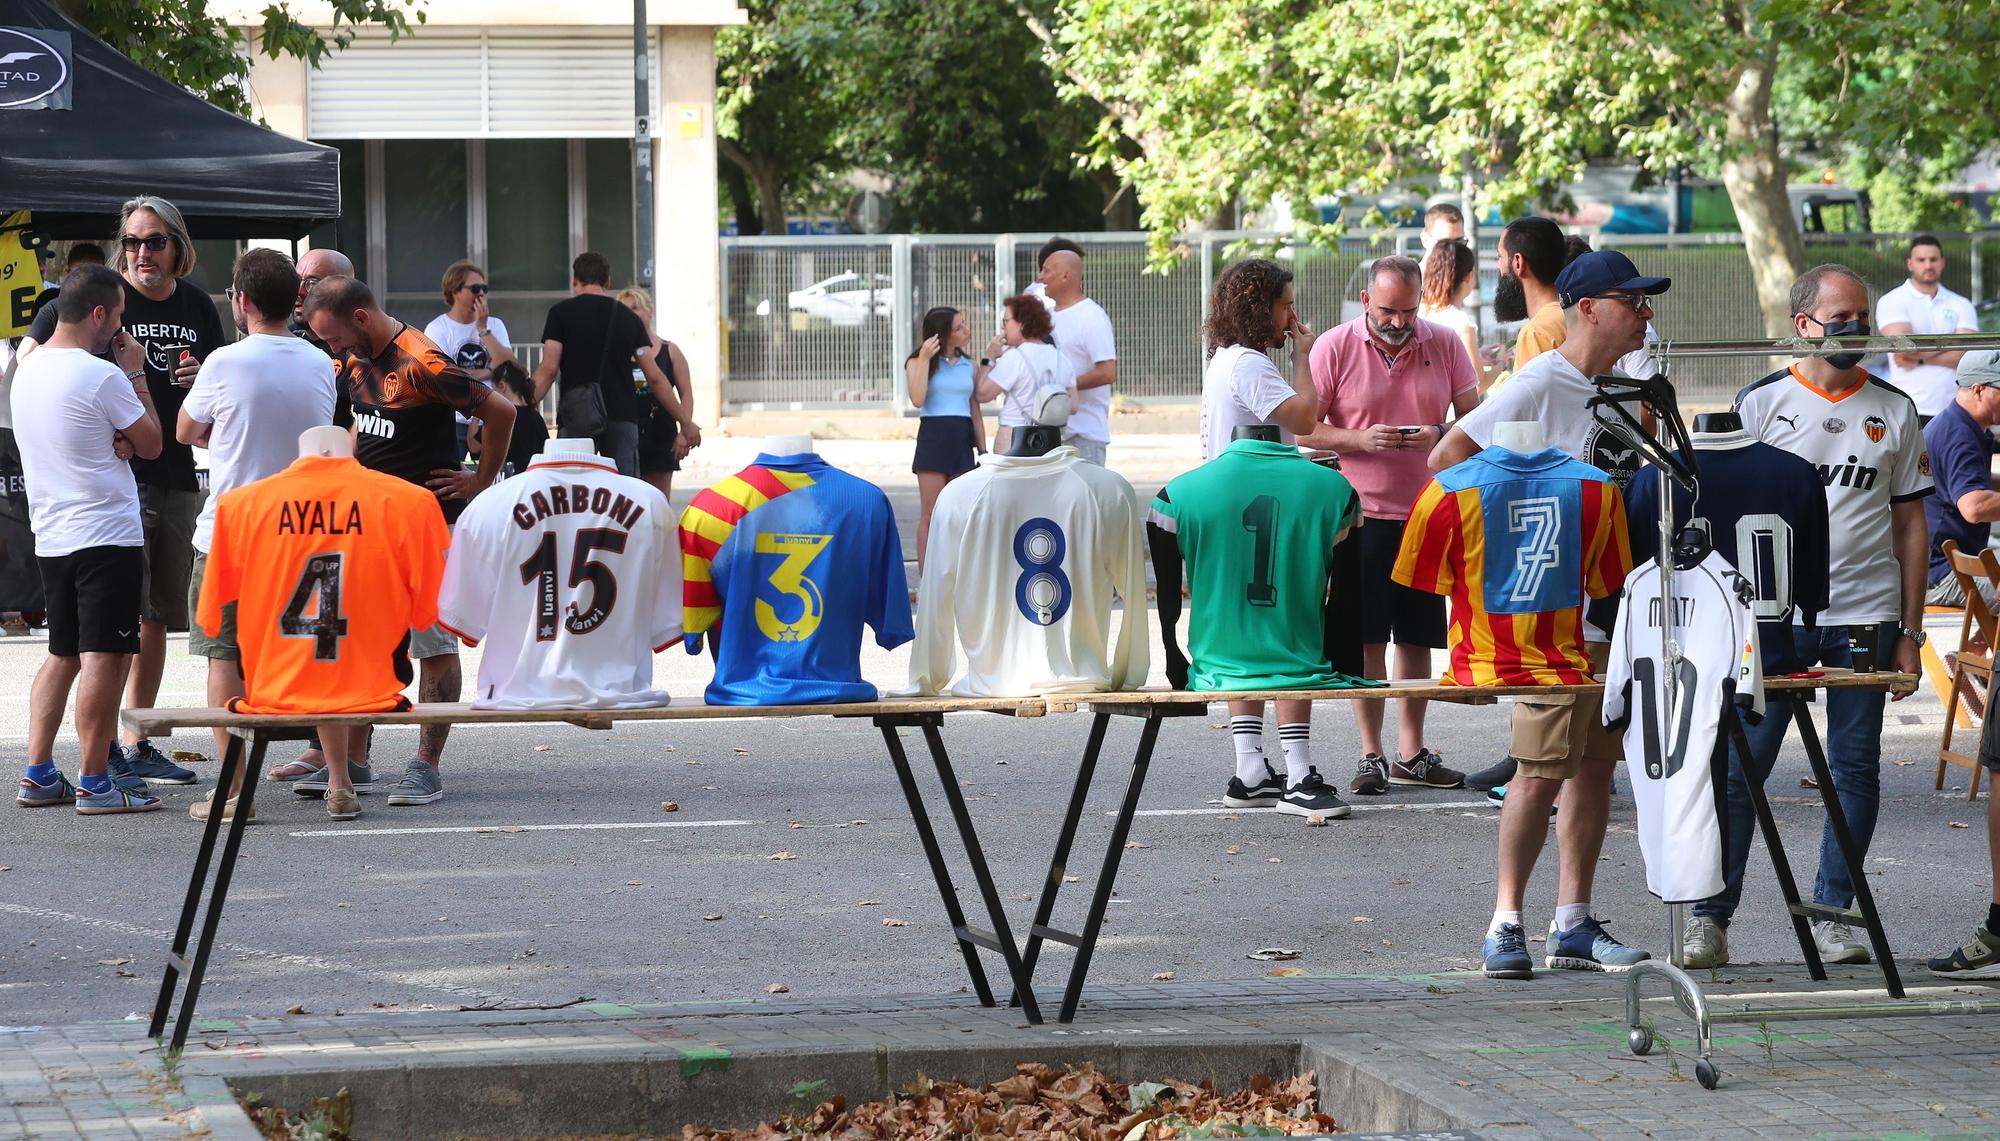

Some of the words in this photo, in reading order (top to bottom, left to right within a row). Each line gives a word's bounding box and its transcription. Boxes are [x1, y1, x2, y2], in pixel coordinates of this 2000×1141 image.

[0, 71, 40, 81] TAD
[153, 352, 167, 362] VC
[10, 475, 26, 492] ES
[1812, 455, 1878, 490] win
[278, 500, 363, 535] AYALA
[513, 484, 645, 531] CARBONI
[1013, 517, 1072, 626] 8
[1242, 494, 1281, 608] 1
[1507, 496, 1561, 602] 7
[279, 552, 348, 663] 4
[519, 527, 628, 642] 15
[542, 570, 554, 616] luanvi
[754, 532, 834, 643] 3
[571, 607, 604, 630] lanvi
